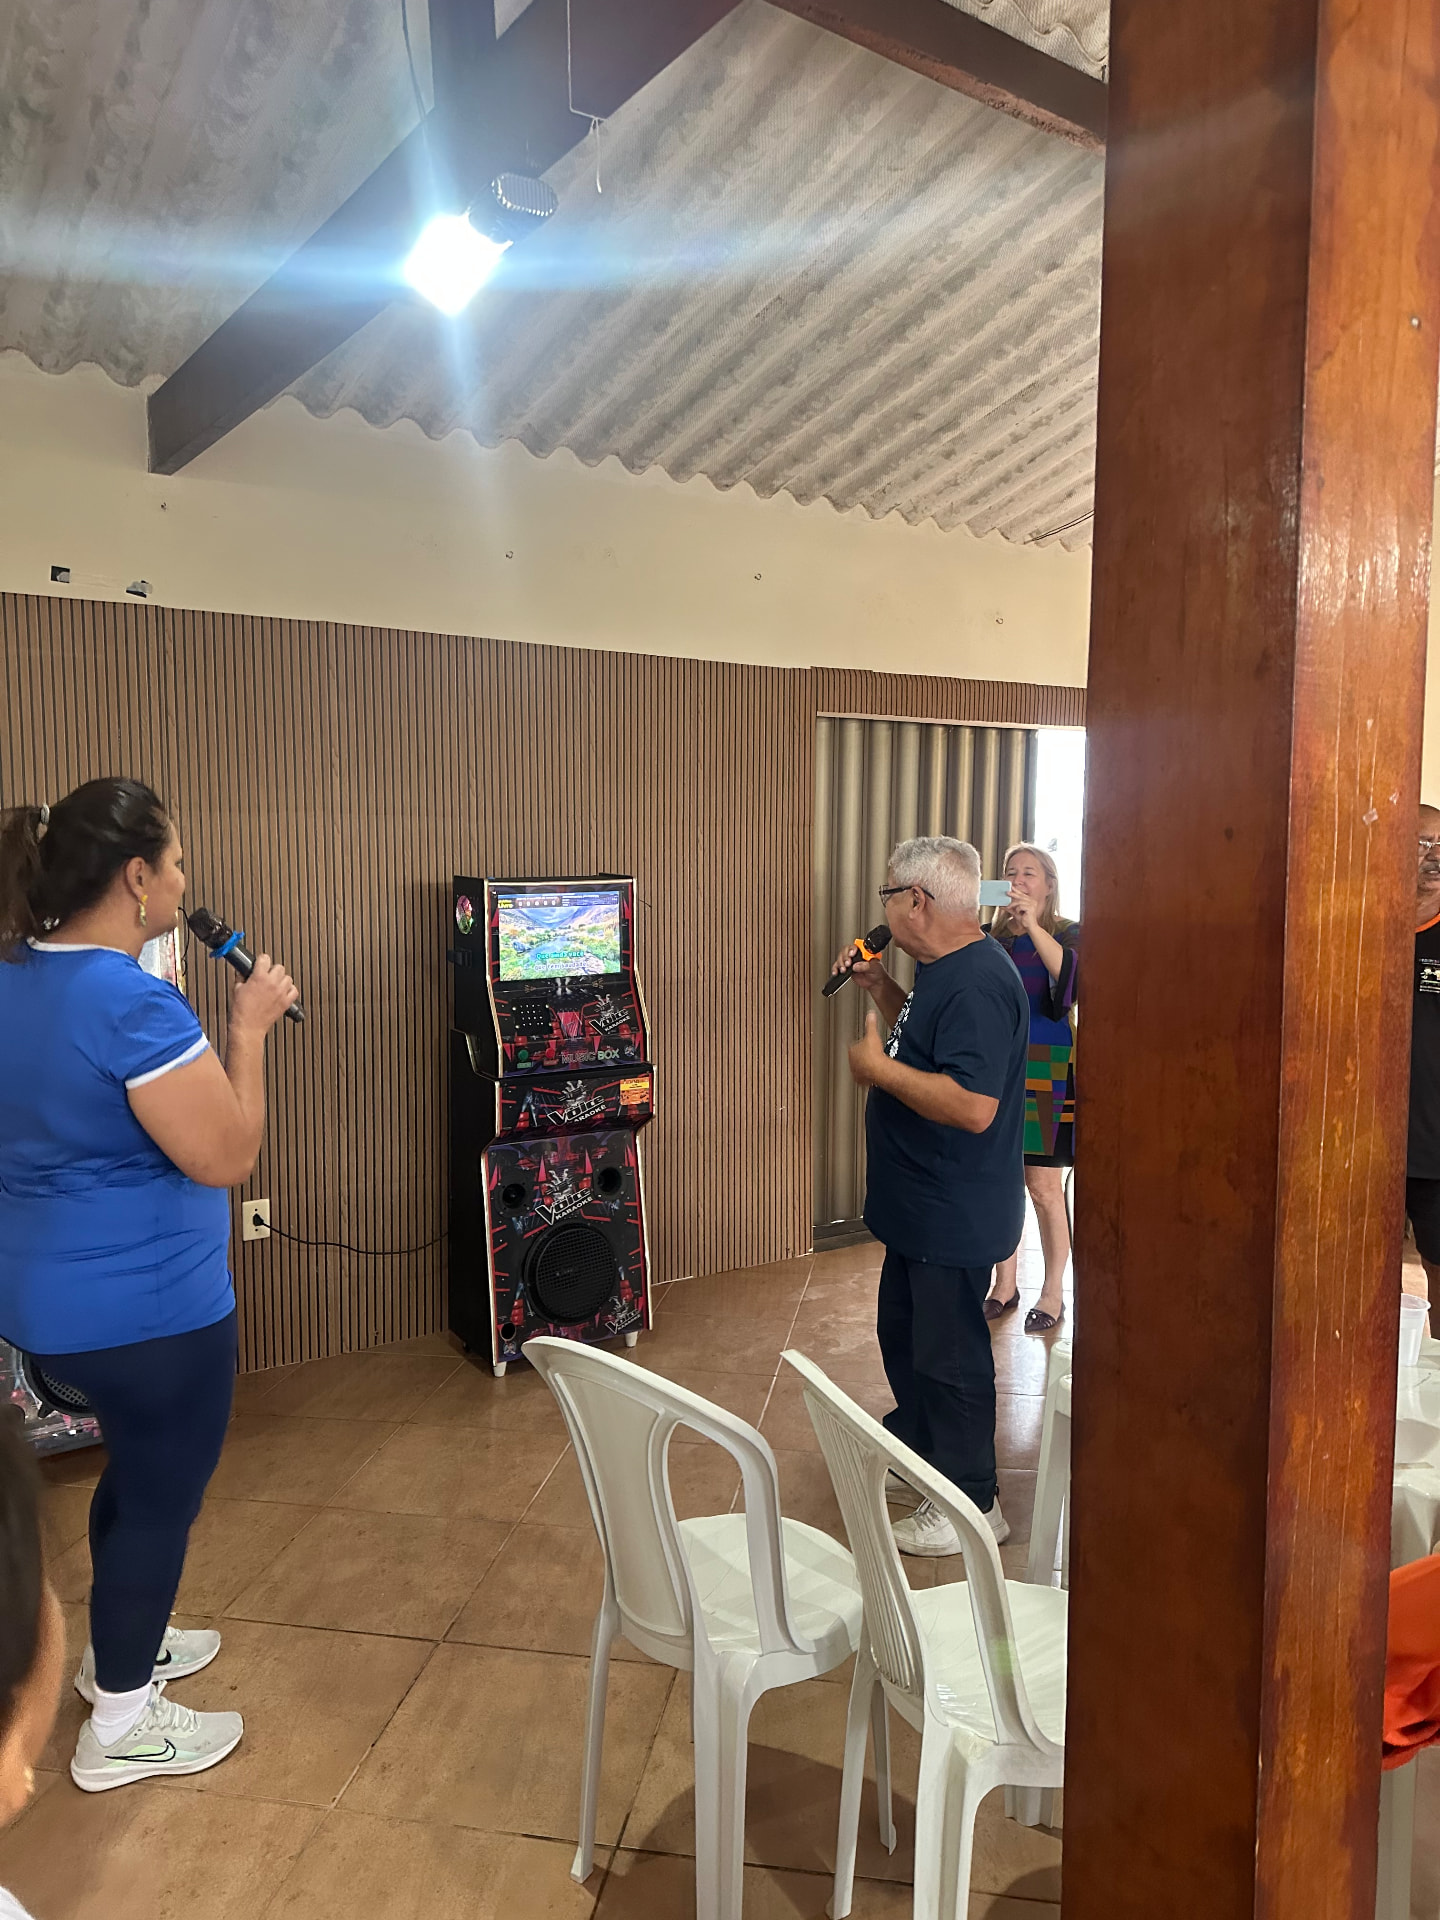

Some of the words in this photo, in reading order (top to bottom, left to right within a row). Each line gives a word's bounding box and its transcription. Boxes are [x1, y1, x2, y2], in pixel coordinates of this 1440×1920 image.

[561, 1051, 596, 1064] MUSIC
[597, 1048, 620, 1060] BOX
[547, 1095, 605, 1127] Voice
[535, 1187, 591, 1226] Voice
[555, 1196, 593, 1221] KARAOKE
